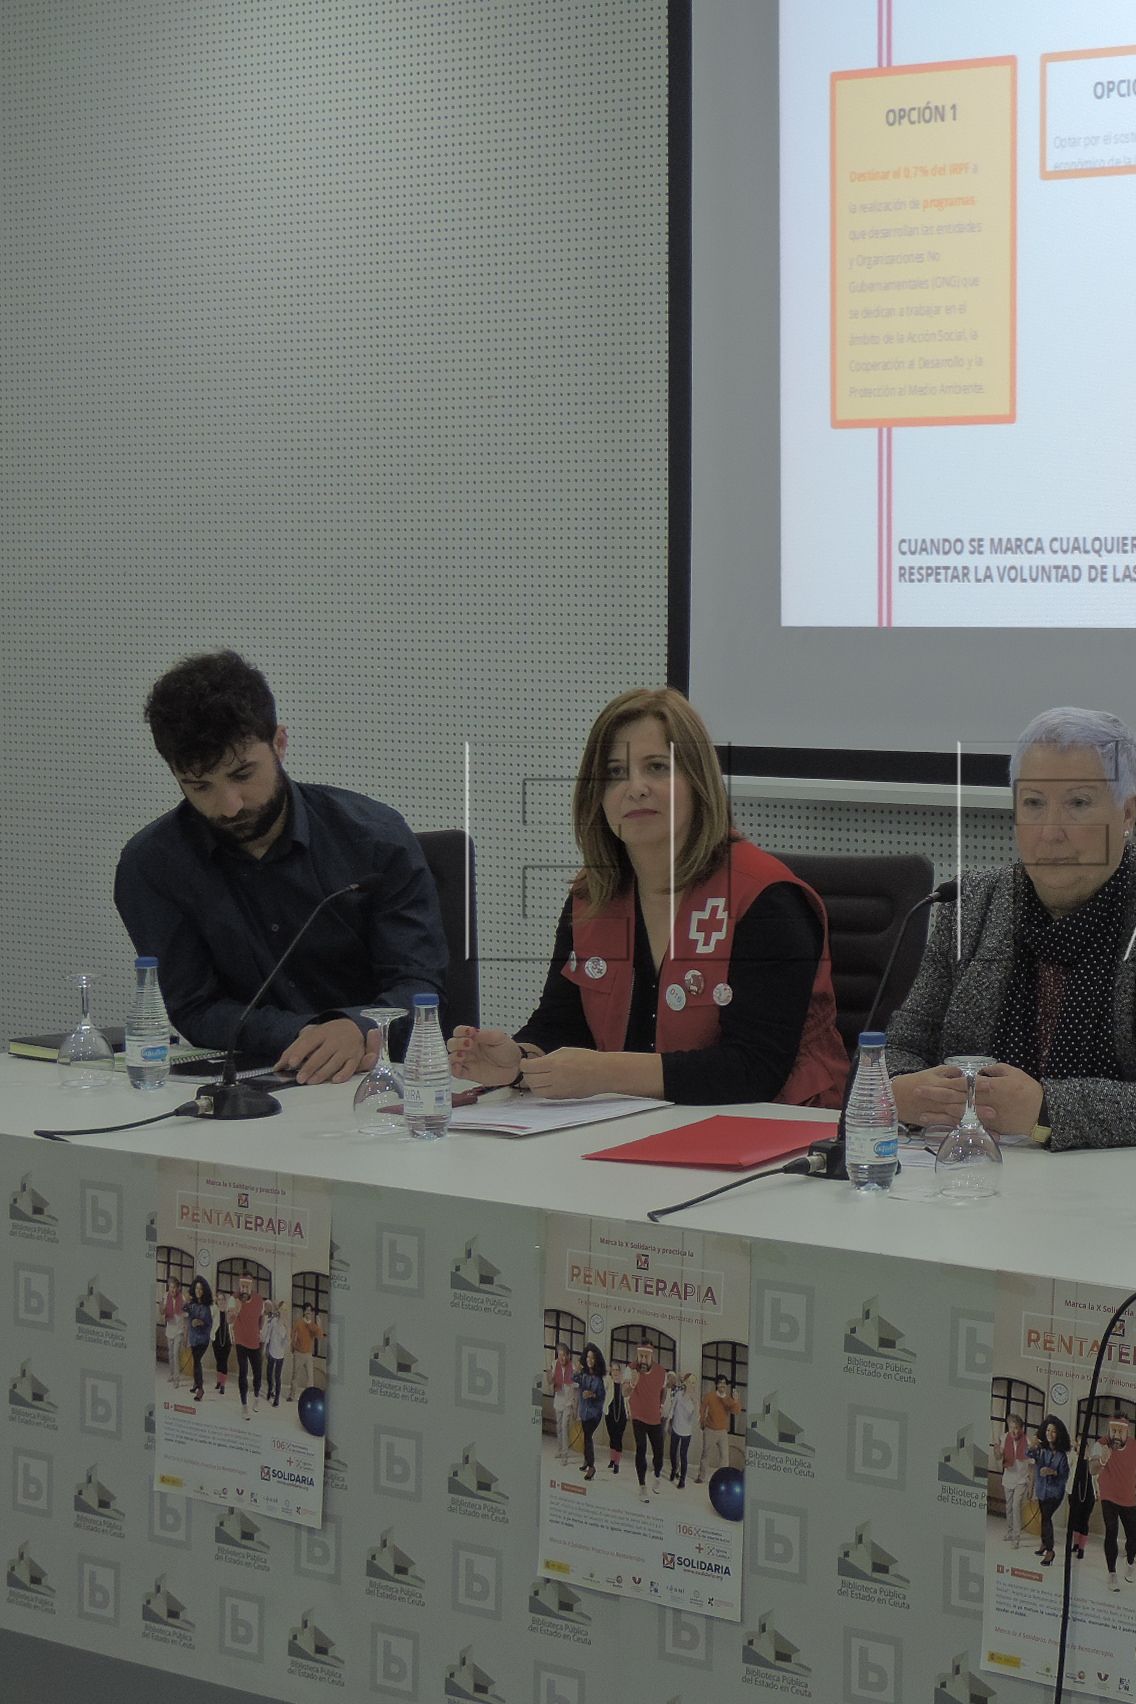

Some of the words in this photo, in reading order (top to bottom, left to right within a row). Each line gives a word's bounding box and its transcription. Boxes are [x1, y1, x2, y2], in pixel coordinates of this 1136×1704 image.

[886, 101, 945, 127] OPCIÓN
[950, 104, 958, 122] 1
[898, 538, 964, 555] CUANDO
[968, 538, 985, 555] SE
[990, 537, 1045, 555] MARCA
[898, 565, 971, 583] RESPETAR
[974, 565, 992, 583] LA
[997, 565, 1081, 583] VOLUNTAD
[1088, 565, 1108, 583] DE
[1065, 1300, 1087, 1310] Marca
[848, 1356, 884, 1369] Biblioteca
[843, 1365, 854, 1374] del
[856, 1366, 881, 1378] Estado
[884, 1372, 892, 1380] en
[894, 1373, 916, 1384] Ceuta
[272, 1469, 314, 1487] SOLIDARIA
[677, 1556, 731, 1576] SOLIDARIA
[841, 1580, 877, 1594] Biblioteca
[837, 1588, 848, 1597] del
[850, 1590, 875, 1604] Estado
[877, 1596, 886, 1604] en
[888, 1598, 910, 1610] Ceuta
